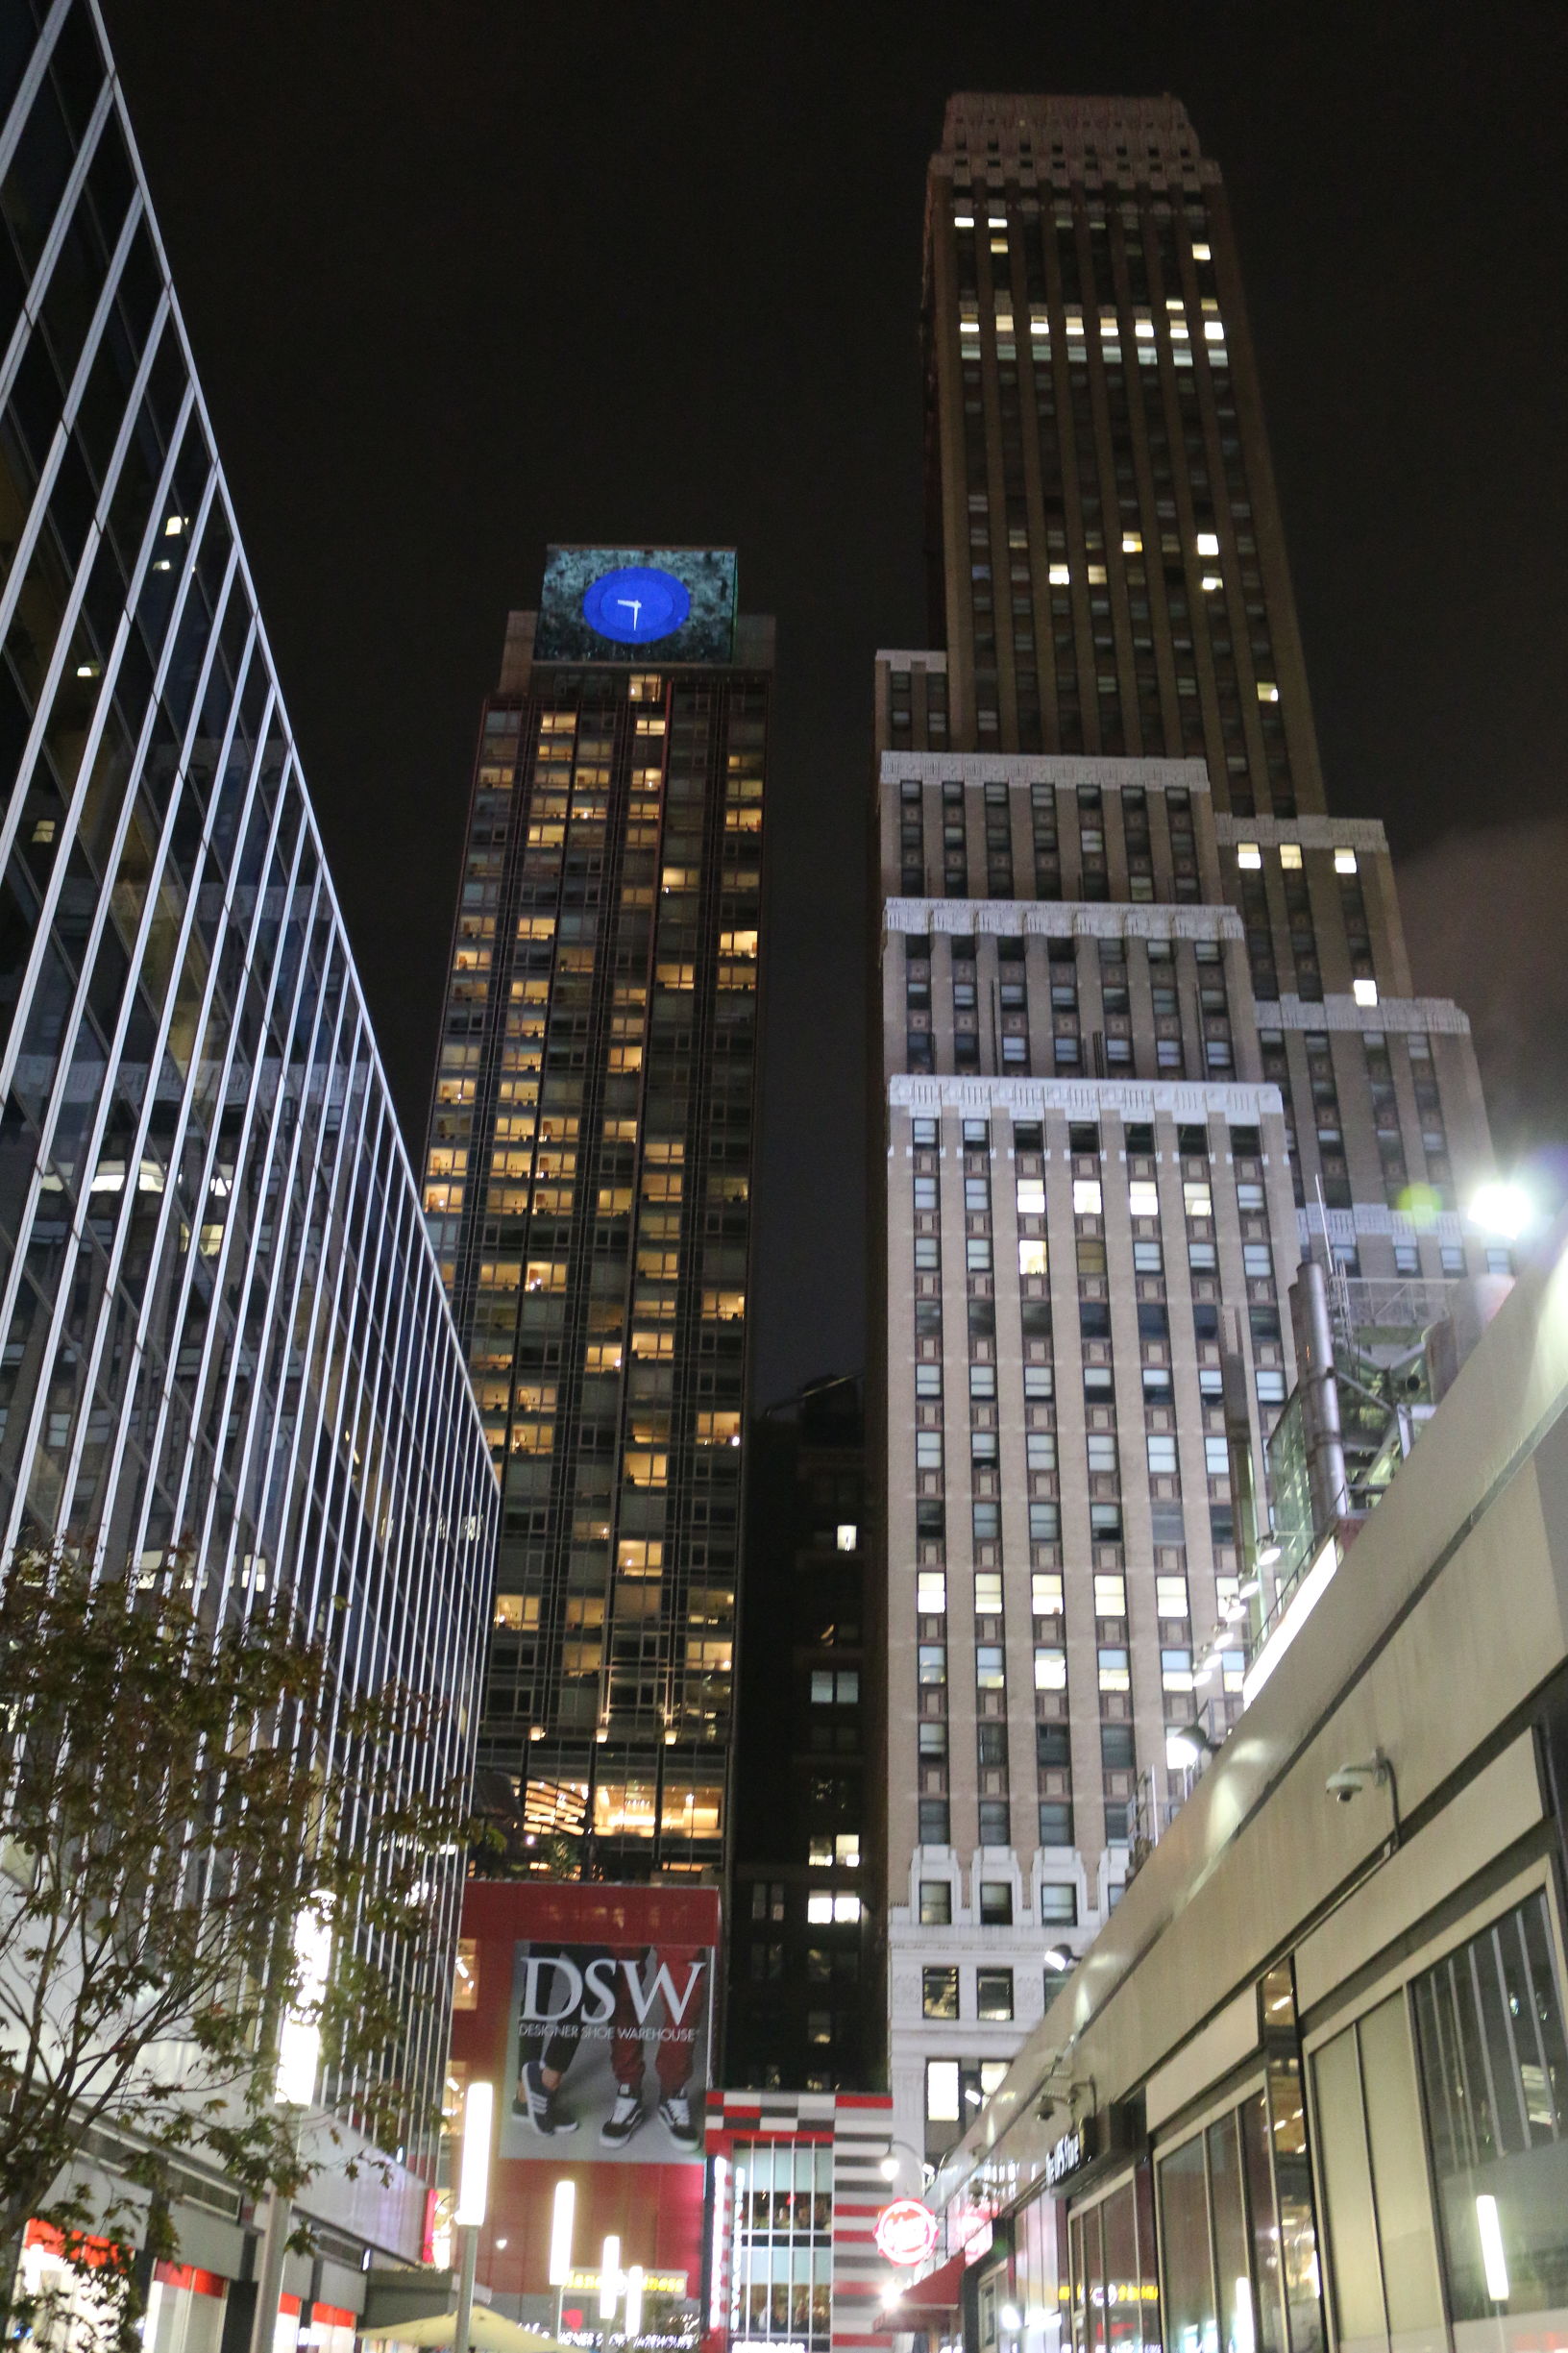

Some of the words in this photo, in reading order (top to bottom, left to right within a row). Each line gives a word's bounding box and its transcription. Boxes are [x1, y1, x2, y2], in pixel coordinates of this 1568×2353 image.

[520, 1957, 707, 2025] DSW
[519, 2022, 578, 2038] DESIGNER
[581, 2025, 614, 2039] SHOE
[618, 2027, 695, 2042] WAREHOUSE
